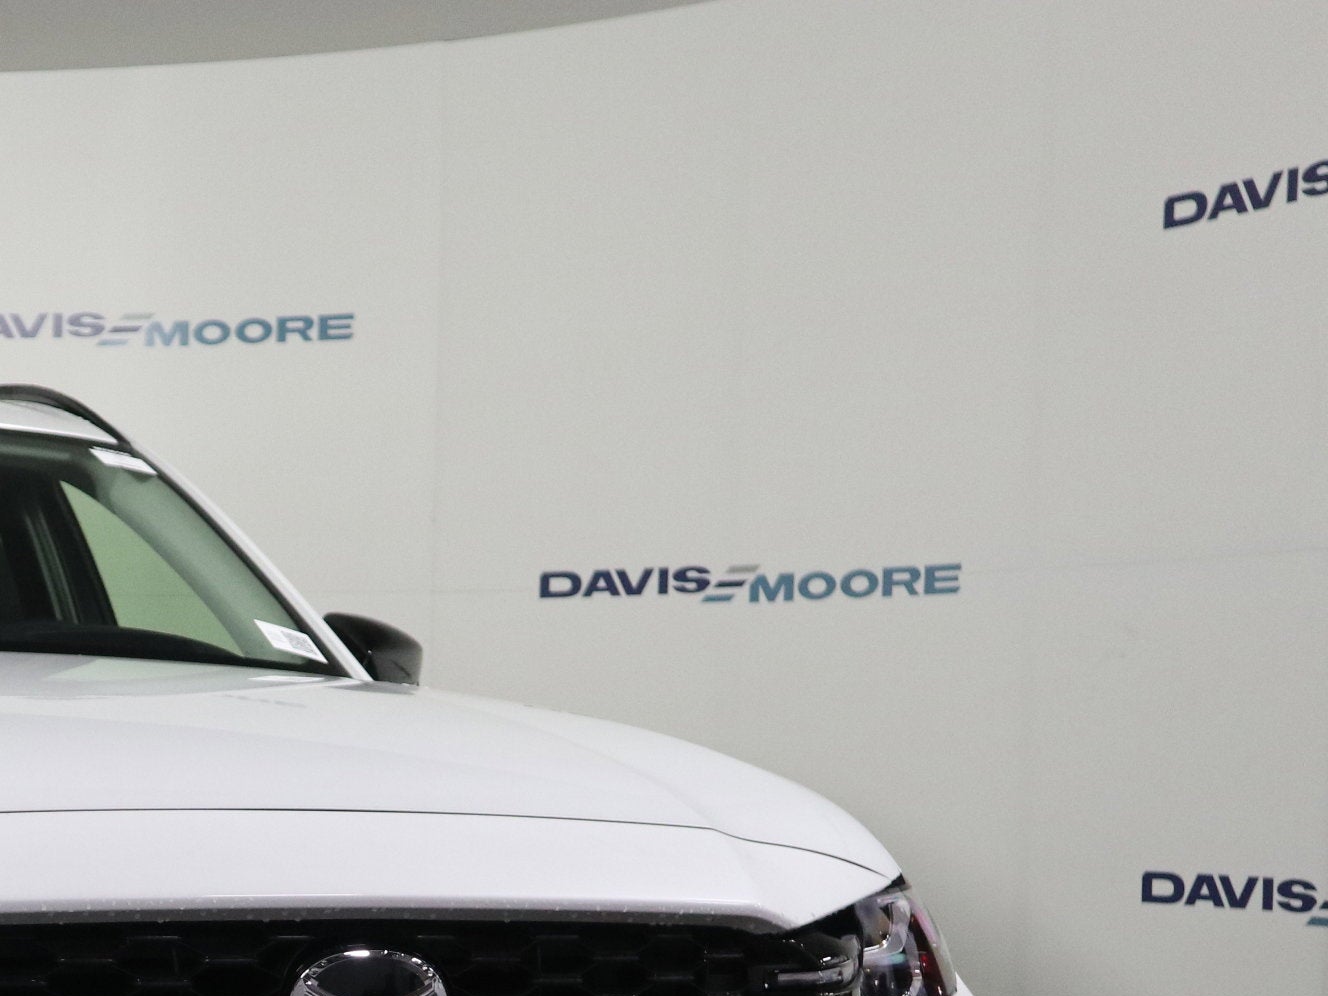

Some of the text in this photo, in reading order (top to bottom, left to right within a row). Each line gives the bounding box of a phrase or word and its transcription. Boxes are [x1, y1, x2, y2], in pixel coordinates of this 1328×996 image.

[1163, 159, 1328, 229] DAVIS
[145, 313, 355, 347] MOORE
[539, 563, 962, 603] DAVIS MOORE
[1141, 870, 1318, 913] DAVIS
